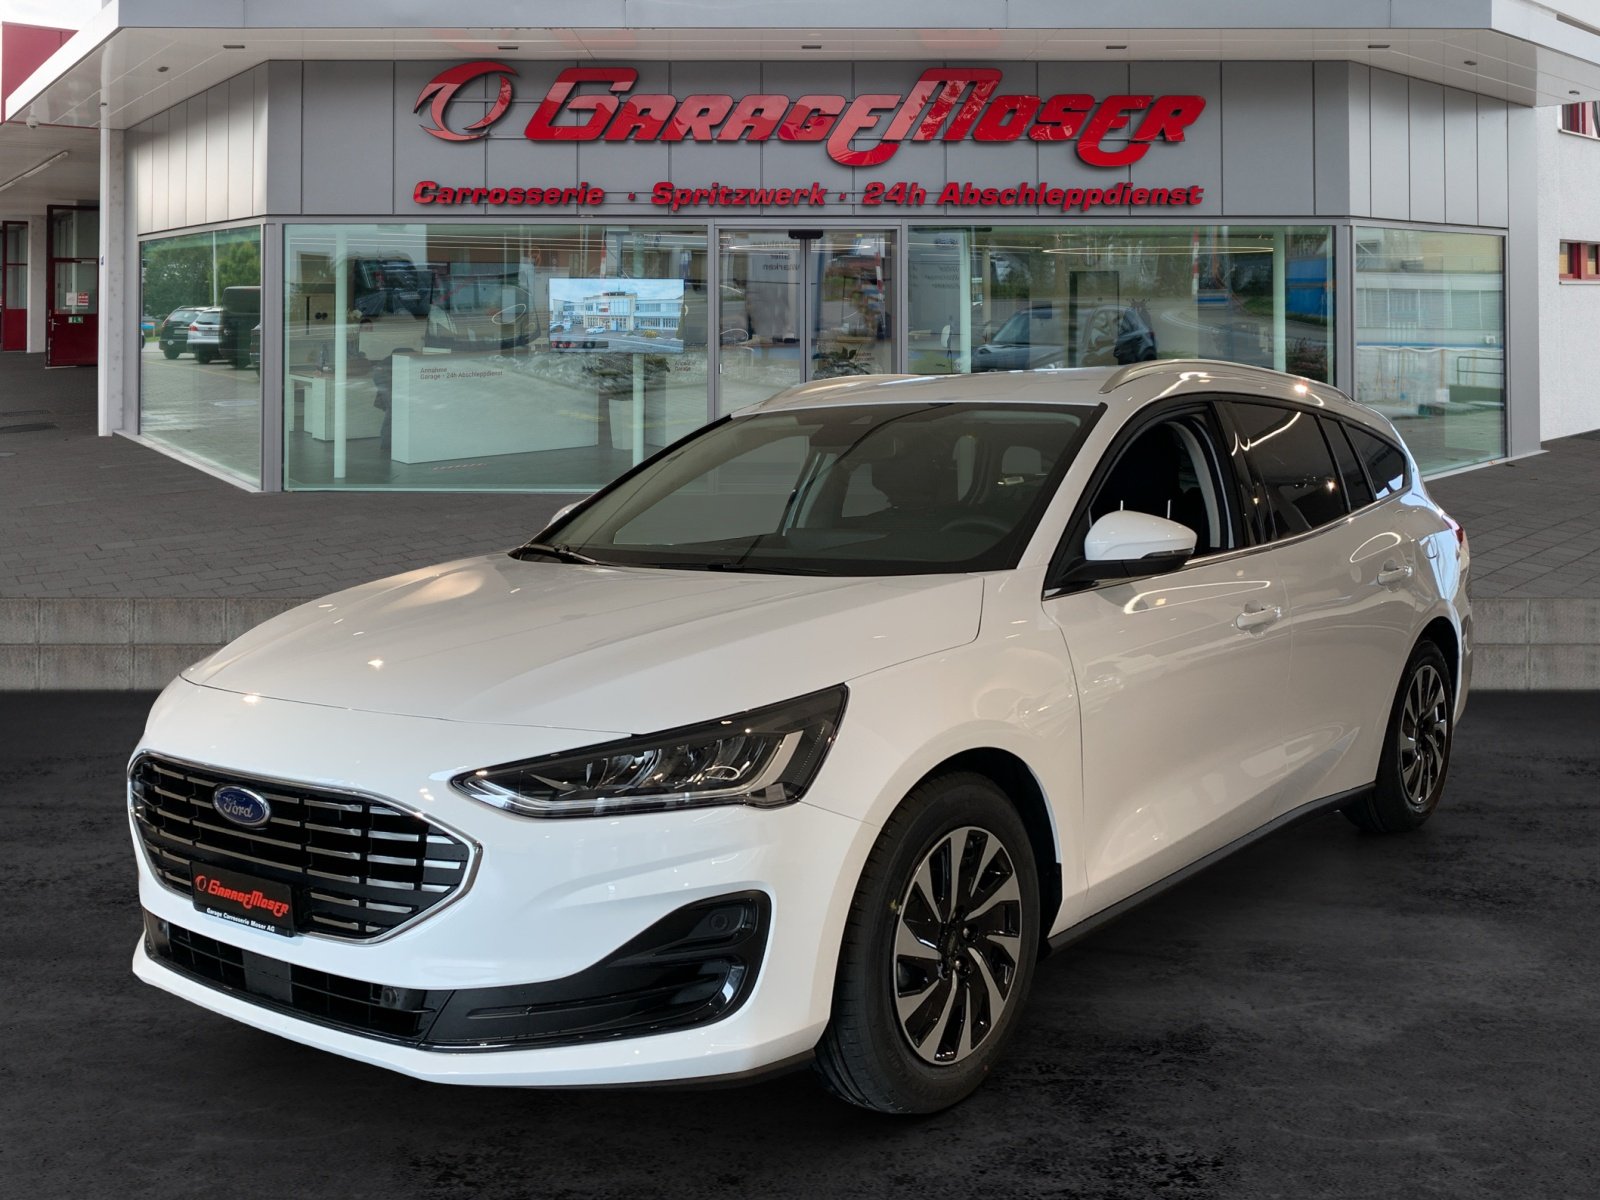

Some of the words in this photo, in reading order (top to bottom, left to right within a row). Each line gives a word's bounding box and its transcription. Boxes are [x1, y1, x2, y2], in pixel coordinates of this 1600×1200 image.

[413, 181, 605, 206] Carrosserie
[650, 182, 827, 212] Spritzwerk
[862, 182, 927, 206] 24h
[936, 182, 1205, 212] Abschleppdienst
[223, 796, 254, 818] Ford
[250, 920, 267, 930] Moser
